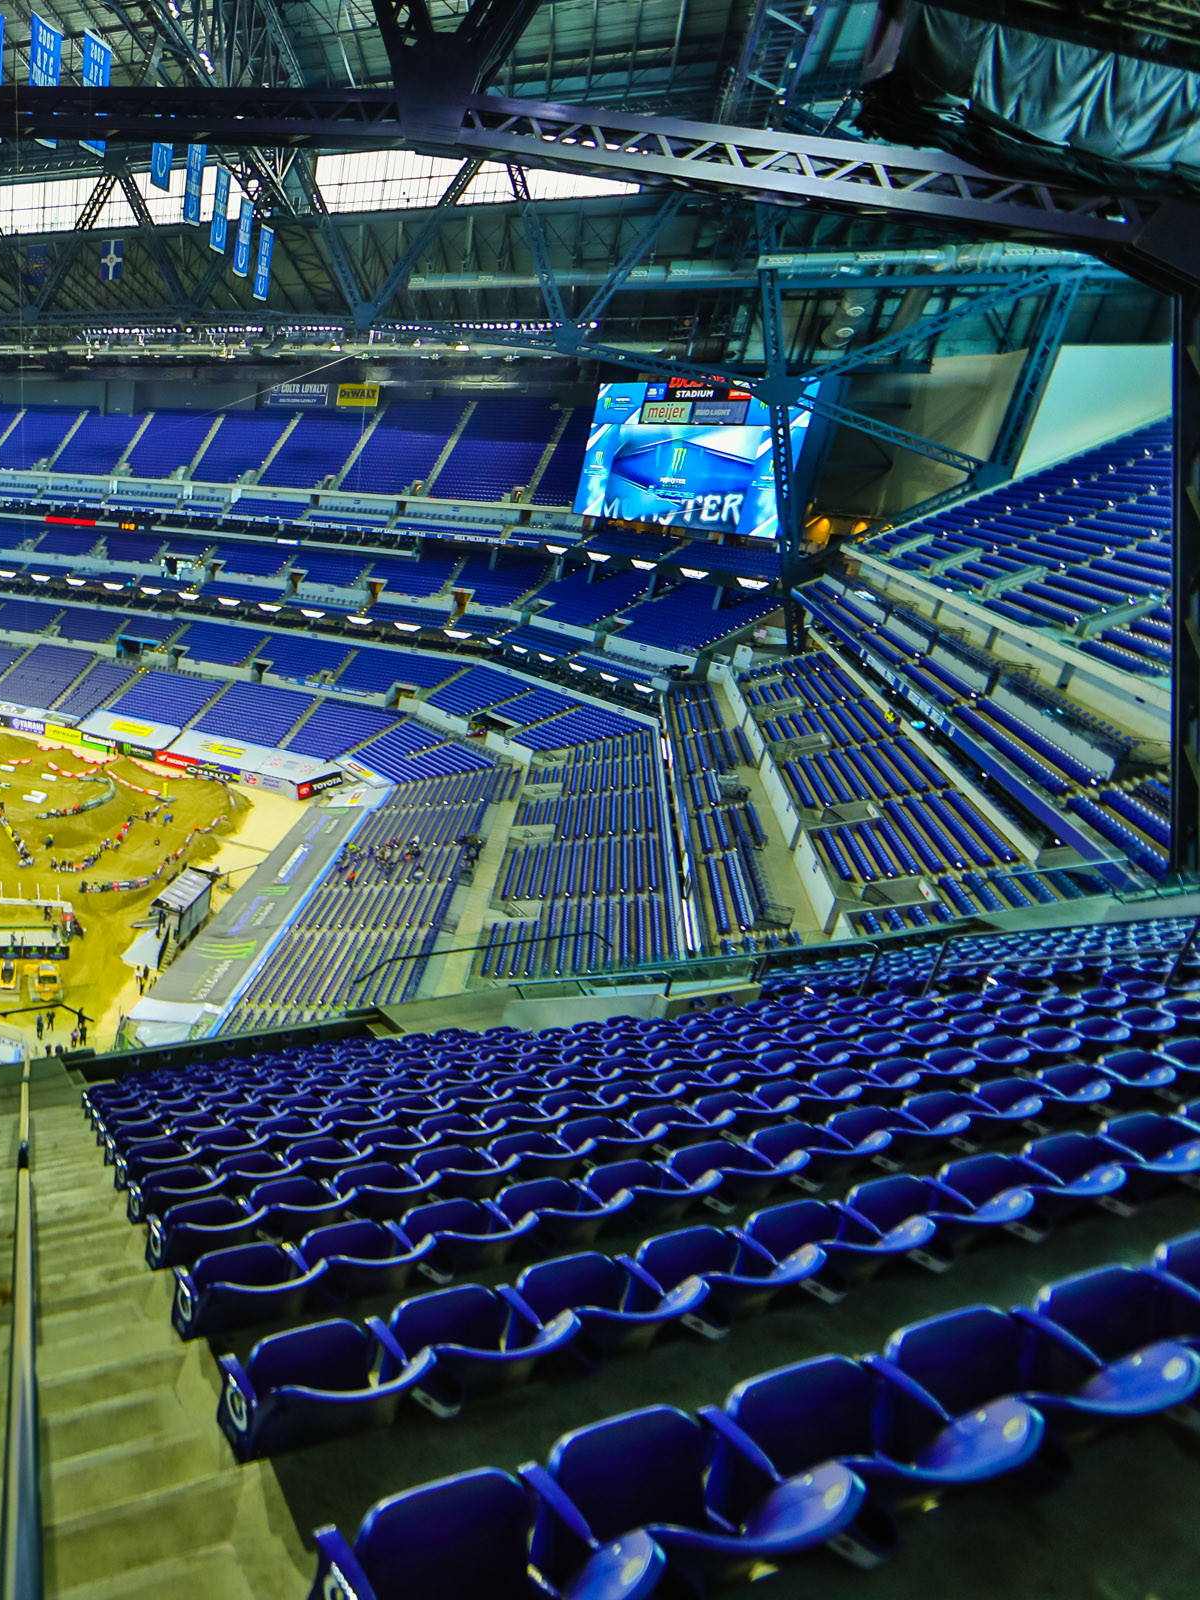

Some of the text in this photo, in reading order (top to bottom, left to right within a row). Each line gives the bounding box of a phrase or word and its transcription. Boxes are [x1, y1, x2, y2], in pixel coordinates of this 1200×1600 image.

[37, 47, 54, 75] AFC
[281, 383, 328, 394] COLTS LOYALTY
[676, 389, 715, 399] STADIUM
[647, 403, 686, 420] meijer
[695, 408, 732, 417] BUD LIGHT
[660, 477, 687, 485] MONSTER
[603, 492, 745, 526] MTER
[304, 680, 320, 688] TEXT
[20, 720, 45, 731] YAMAHA
[52, 729, 80, 739] DUNLOP
[82, 733, 117, 748] Kawasaki
[167, 757, 196, 768] HON
[197, 769, 230, 781] OAKLEY
[312, 777, 343, 791] TOYOTA
